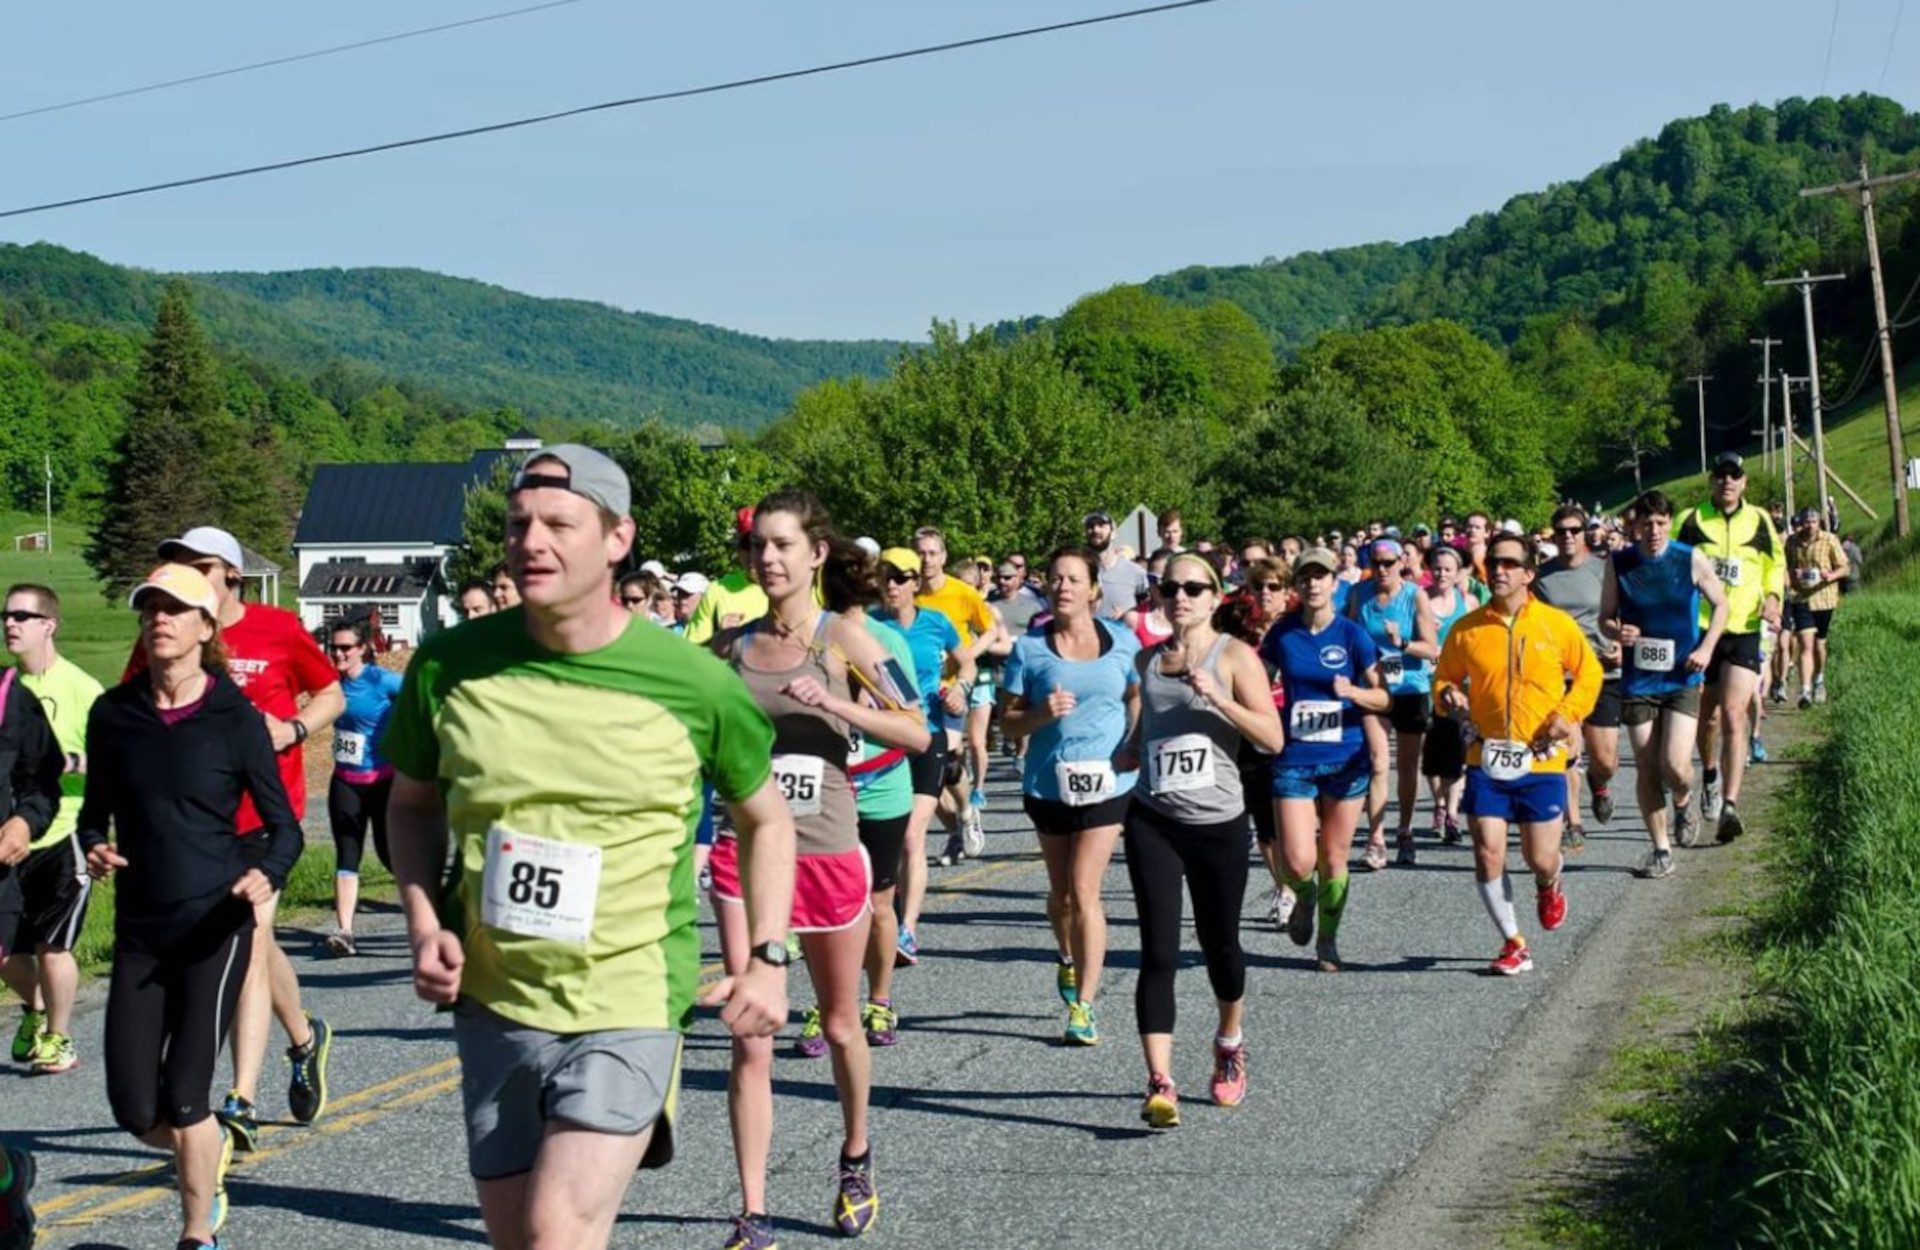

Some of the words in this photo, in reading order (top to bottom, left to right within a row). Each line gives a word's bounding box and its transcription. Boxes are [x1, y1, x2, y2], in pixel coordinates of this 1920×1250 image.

[1296, 711, 1338, 729] 1170
[1155, 748, 1207, 777] 1757
[1490, 749, 1523, 768] 753
[774, 772, 816, 800] 35
[1069, 773, 1104, 792] 637
[508, 861, 564, 909] 85
